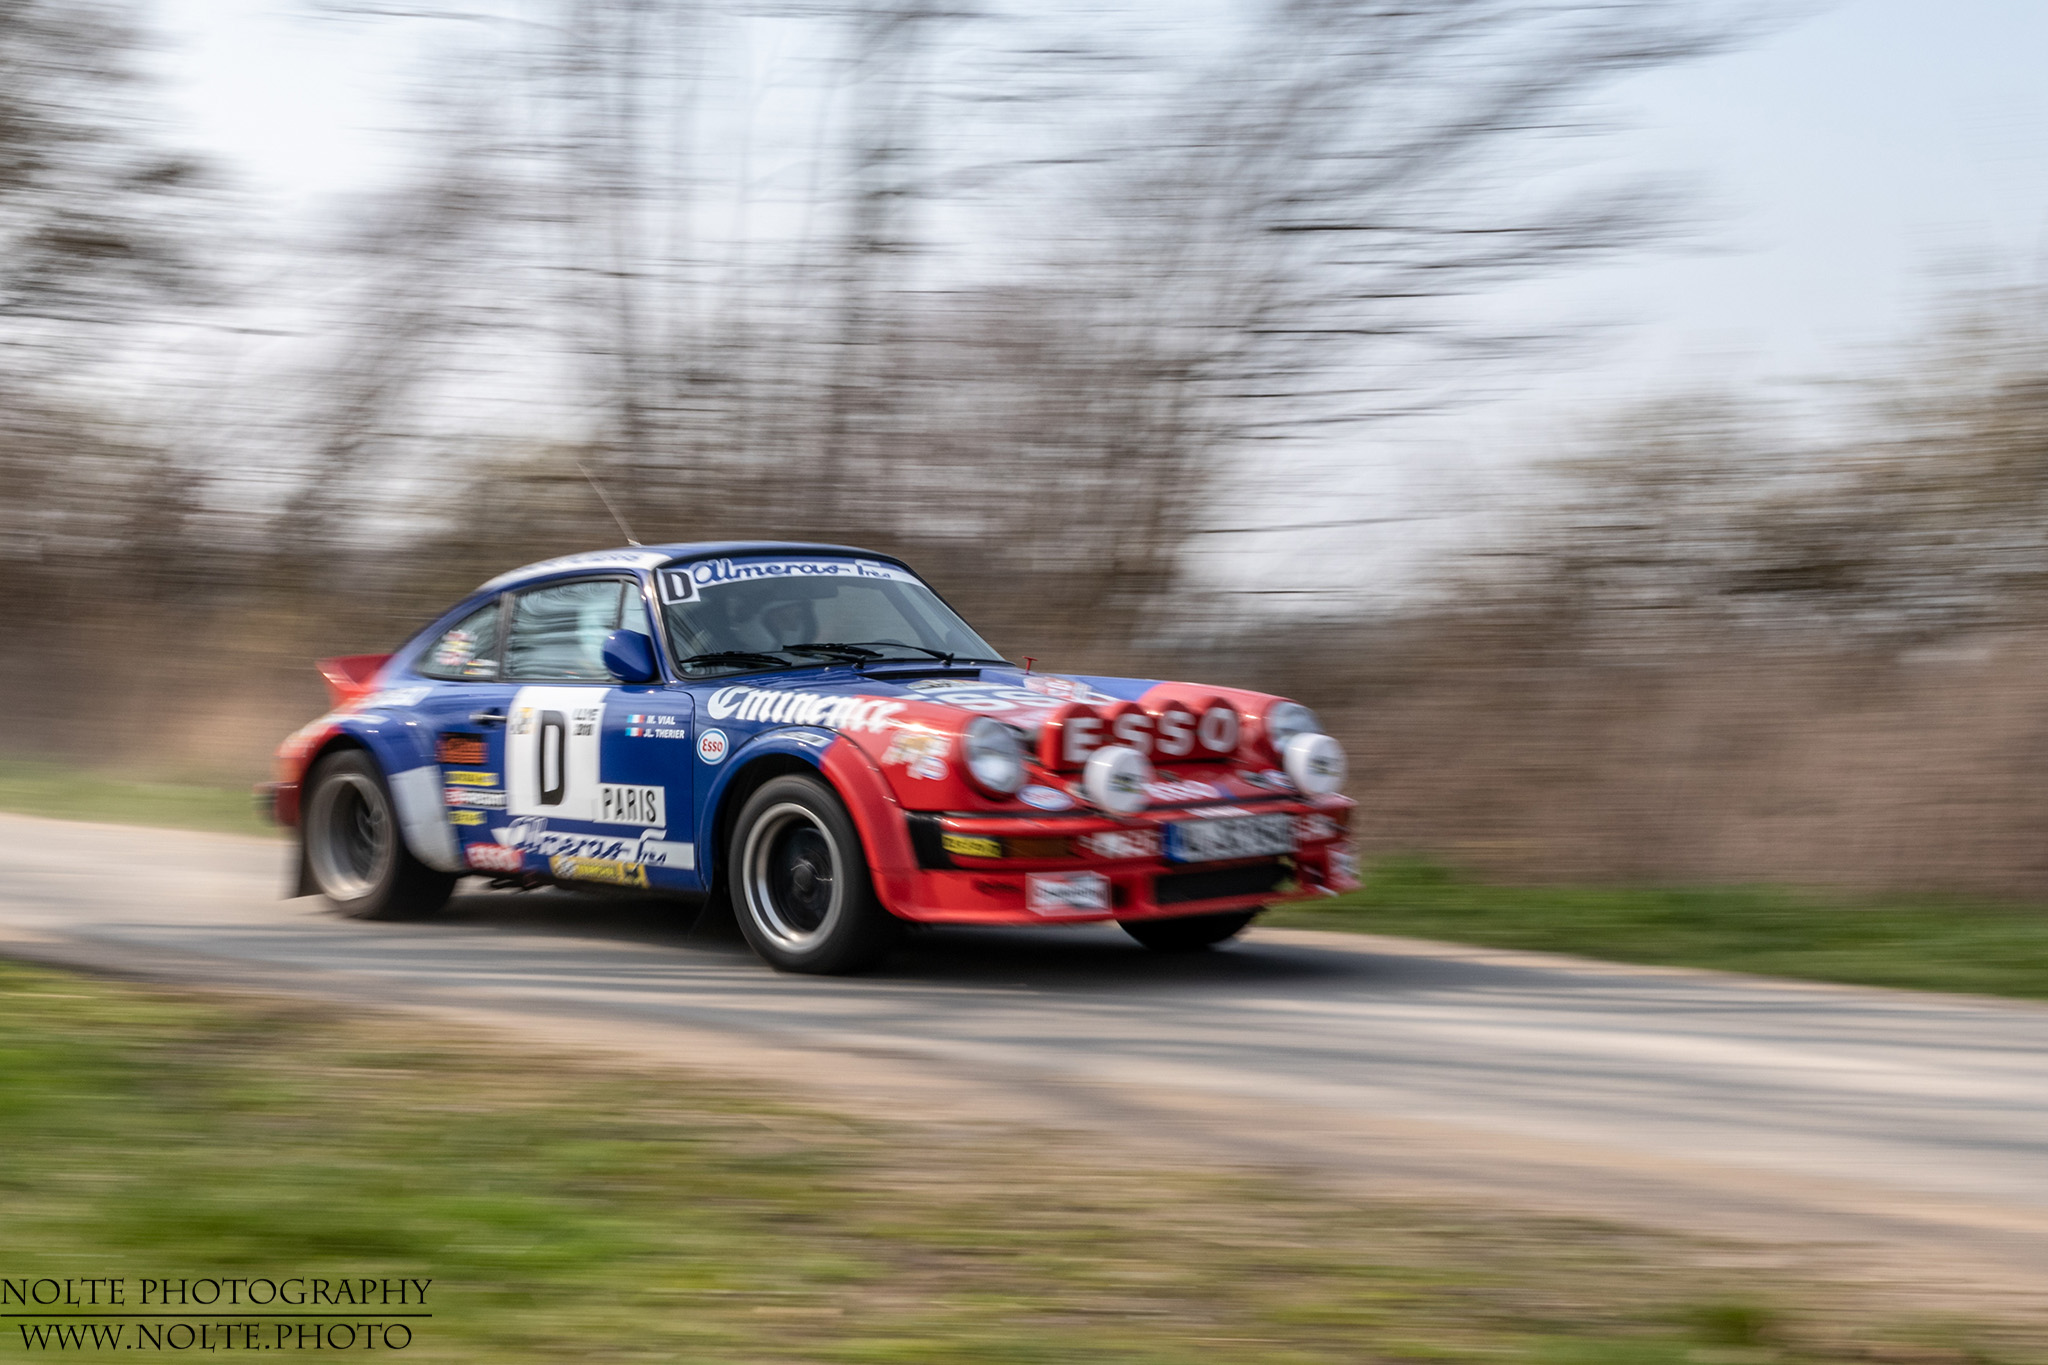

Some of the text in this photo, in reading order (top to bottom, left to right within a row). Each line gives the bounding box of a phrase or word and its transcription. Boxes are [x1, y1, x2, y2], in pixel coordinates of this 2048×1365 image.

[664, 571, 692, 600] D
[655, 729, 685, 739] THERIER
[658, 716, 676, 725] VIAL
[1062, 706, 1240, 764] ESSO
[539, 709, 566, 806] D
[602, 787, 657, 823] PARIS
